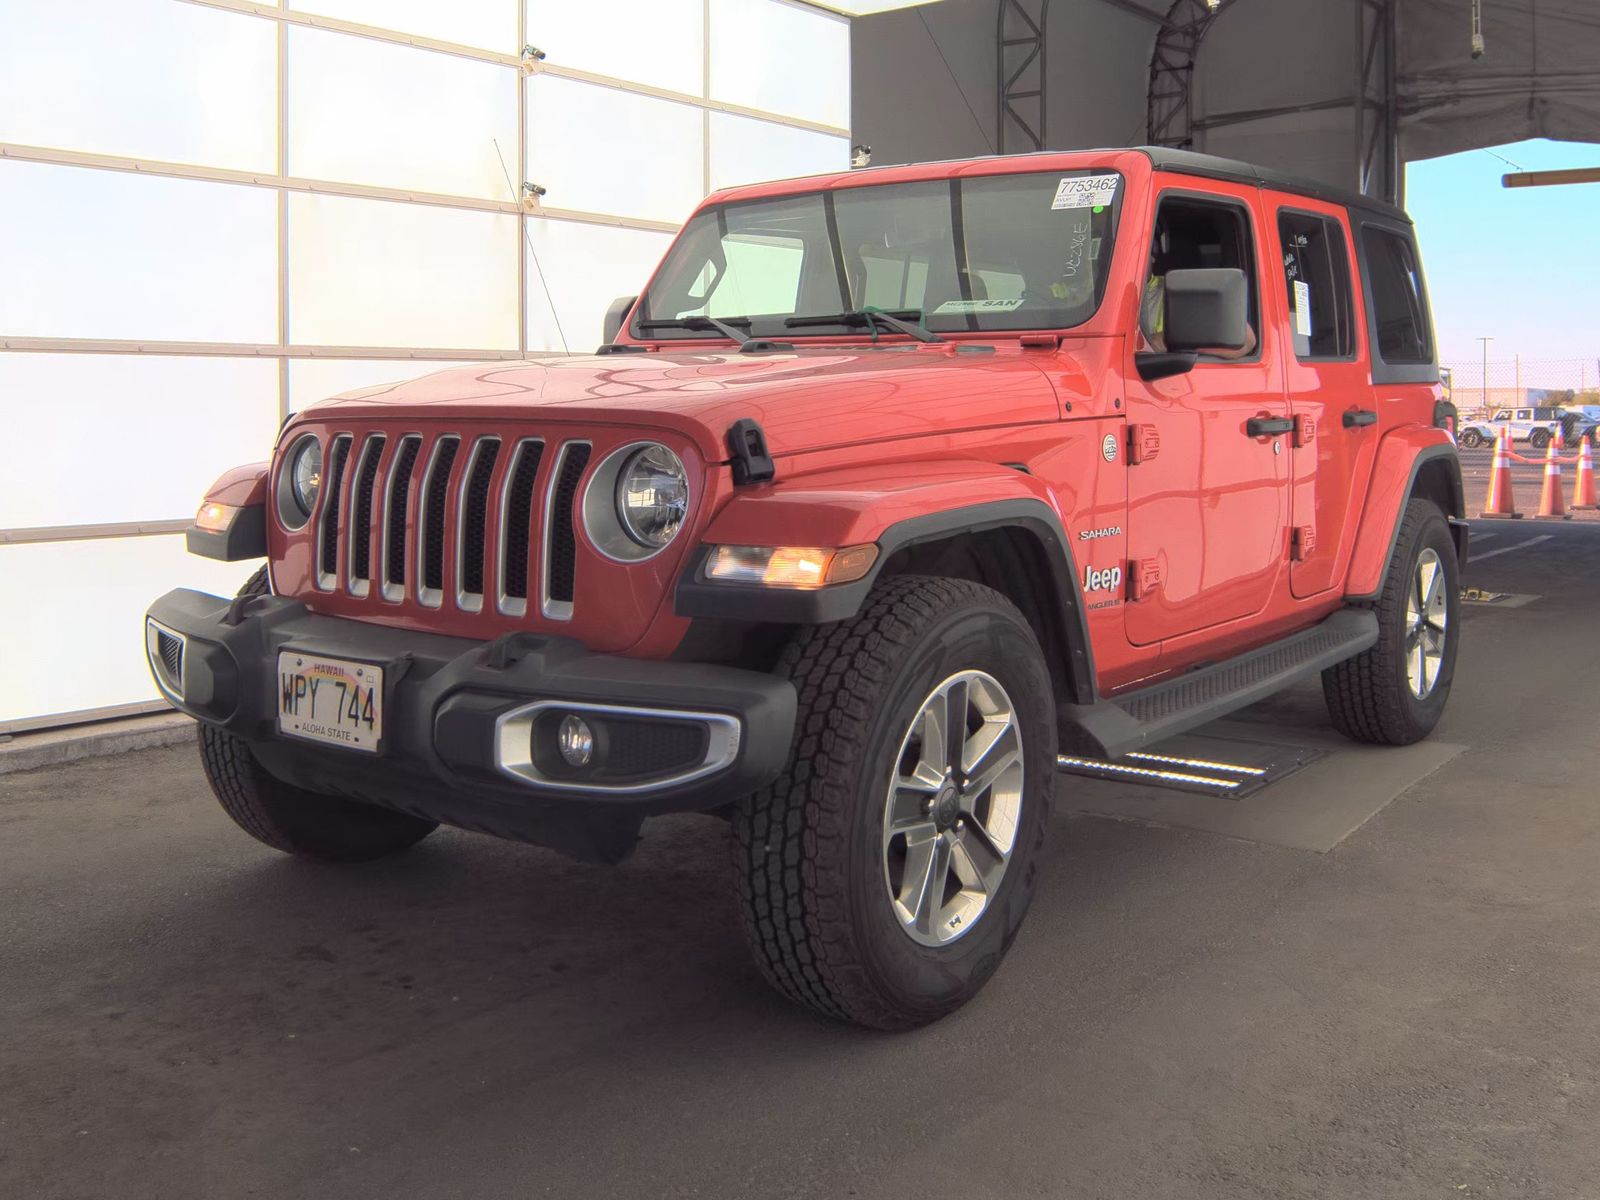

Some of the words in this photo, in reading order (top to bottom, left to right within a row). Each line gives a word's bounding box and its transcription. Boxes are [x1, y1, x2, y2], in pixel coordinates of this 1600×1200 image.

[1061, 177, 1118, 194] 7753462
[1079, 526, 1122, 541] SAHARA
[1083, 564, 1122, 592] Jeep
[314, 663, 345, 677] HAWAII
[282, 672, 320, 719] WPY
[335, 681, 374, 731] 744
[302, 723, 326, 735] ALOHA
[327, 728, 352, 741] STATE
